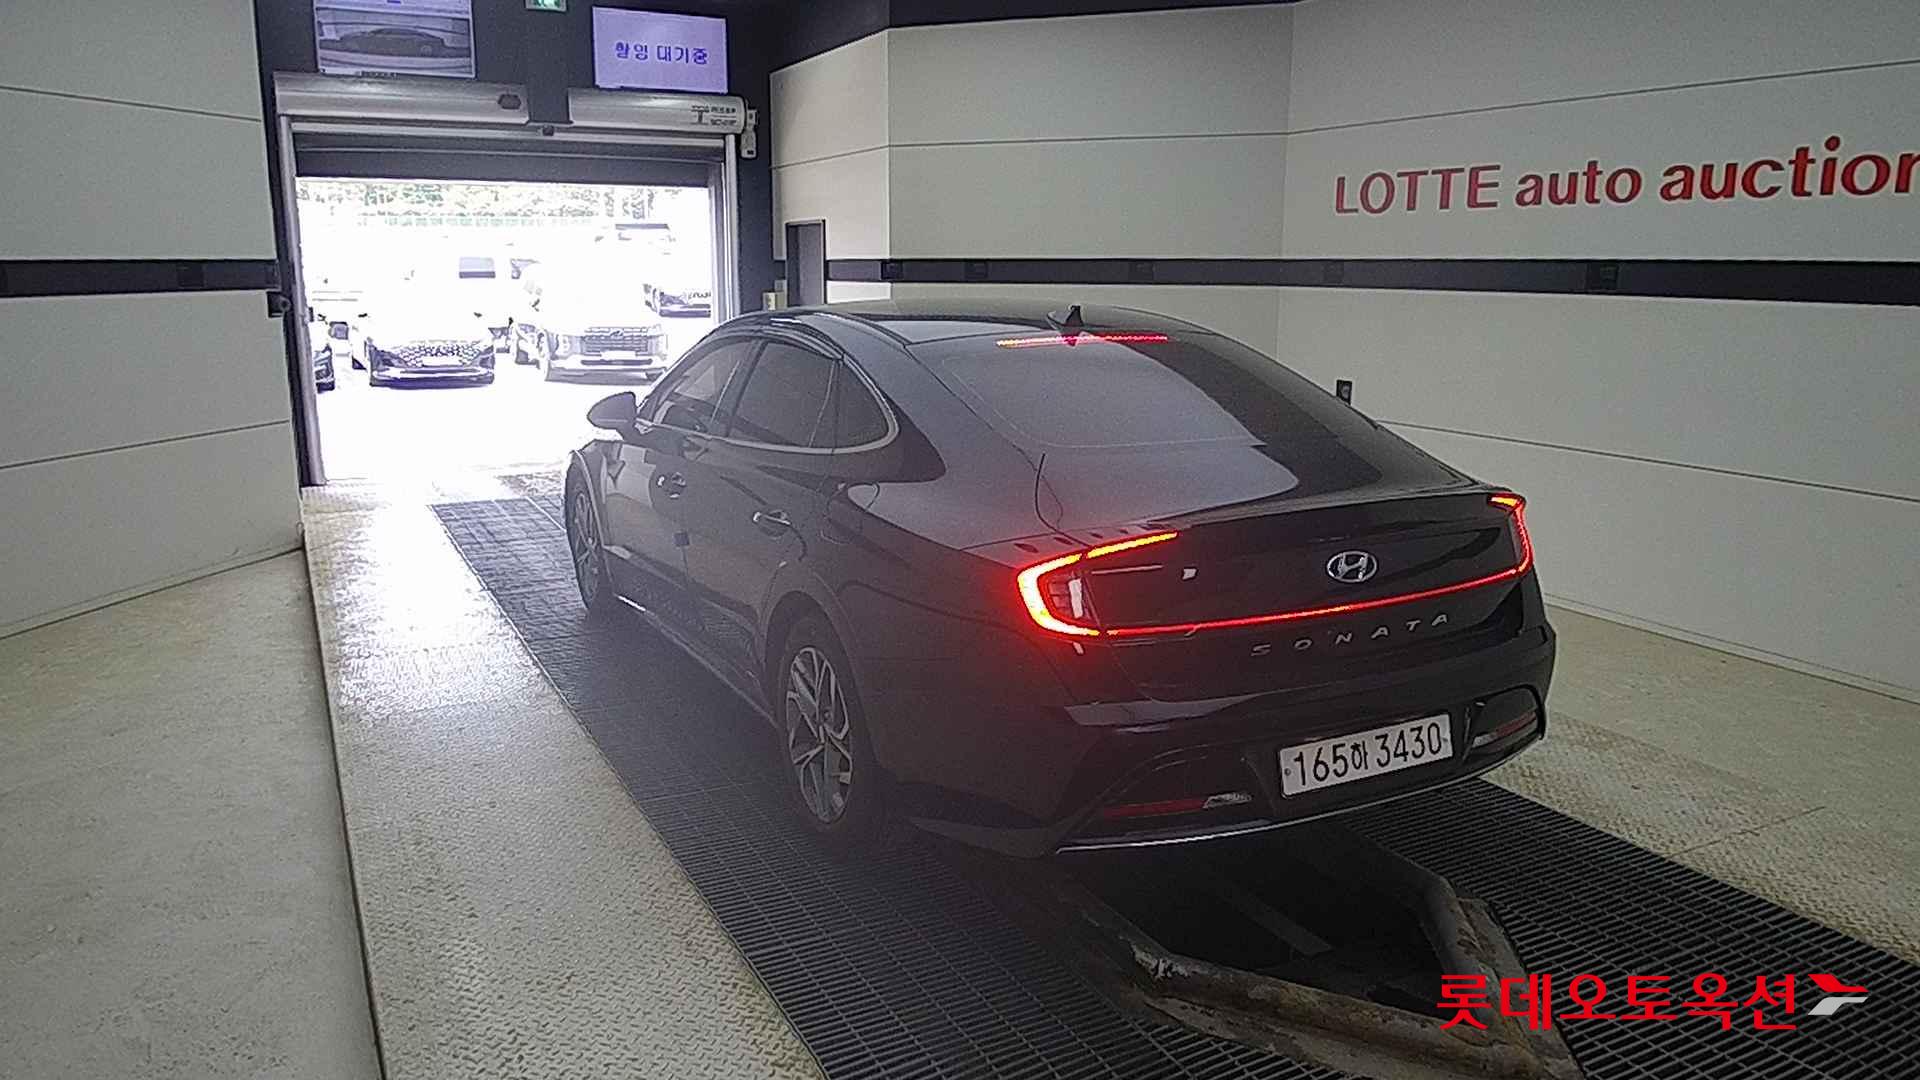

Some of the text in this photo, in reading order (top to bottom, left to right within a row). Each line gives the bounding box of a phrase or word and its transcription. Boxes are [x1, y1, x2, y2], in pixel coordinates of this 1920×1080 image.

[656, 45, 708, 65] 대기중
[1335, 164, 1501, 214] LOTTE
[1515, 160, 1642, 207] auto
[1251, 614, 1448, 656] SONATA
[1375, 722, 1442, 768] 3430
